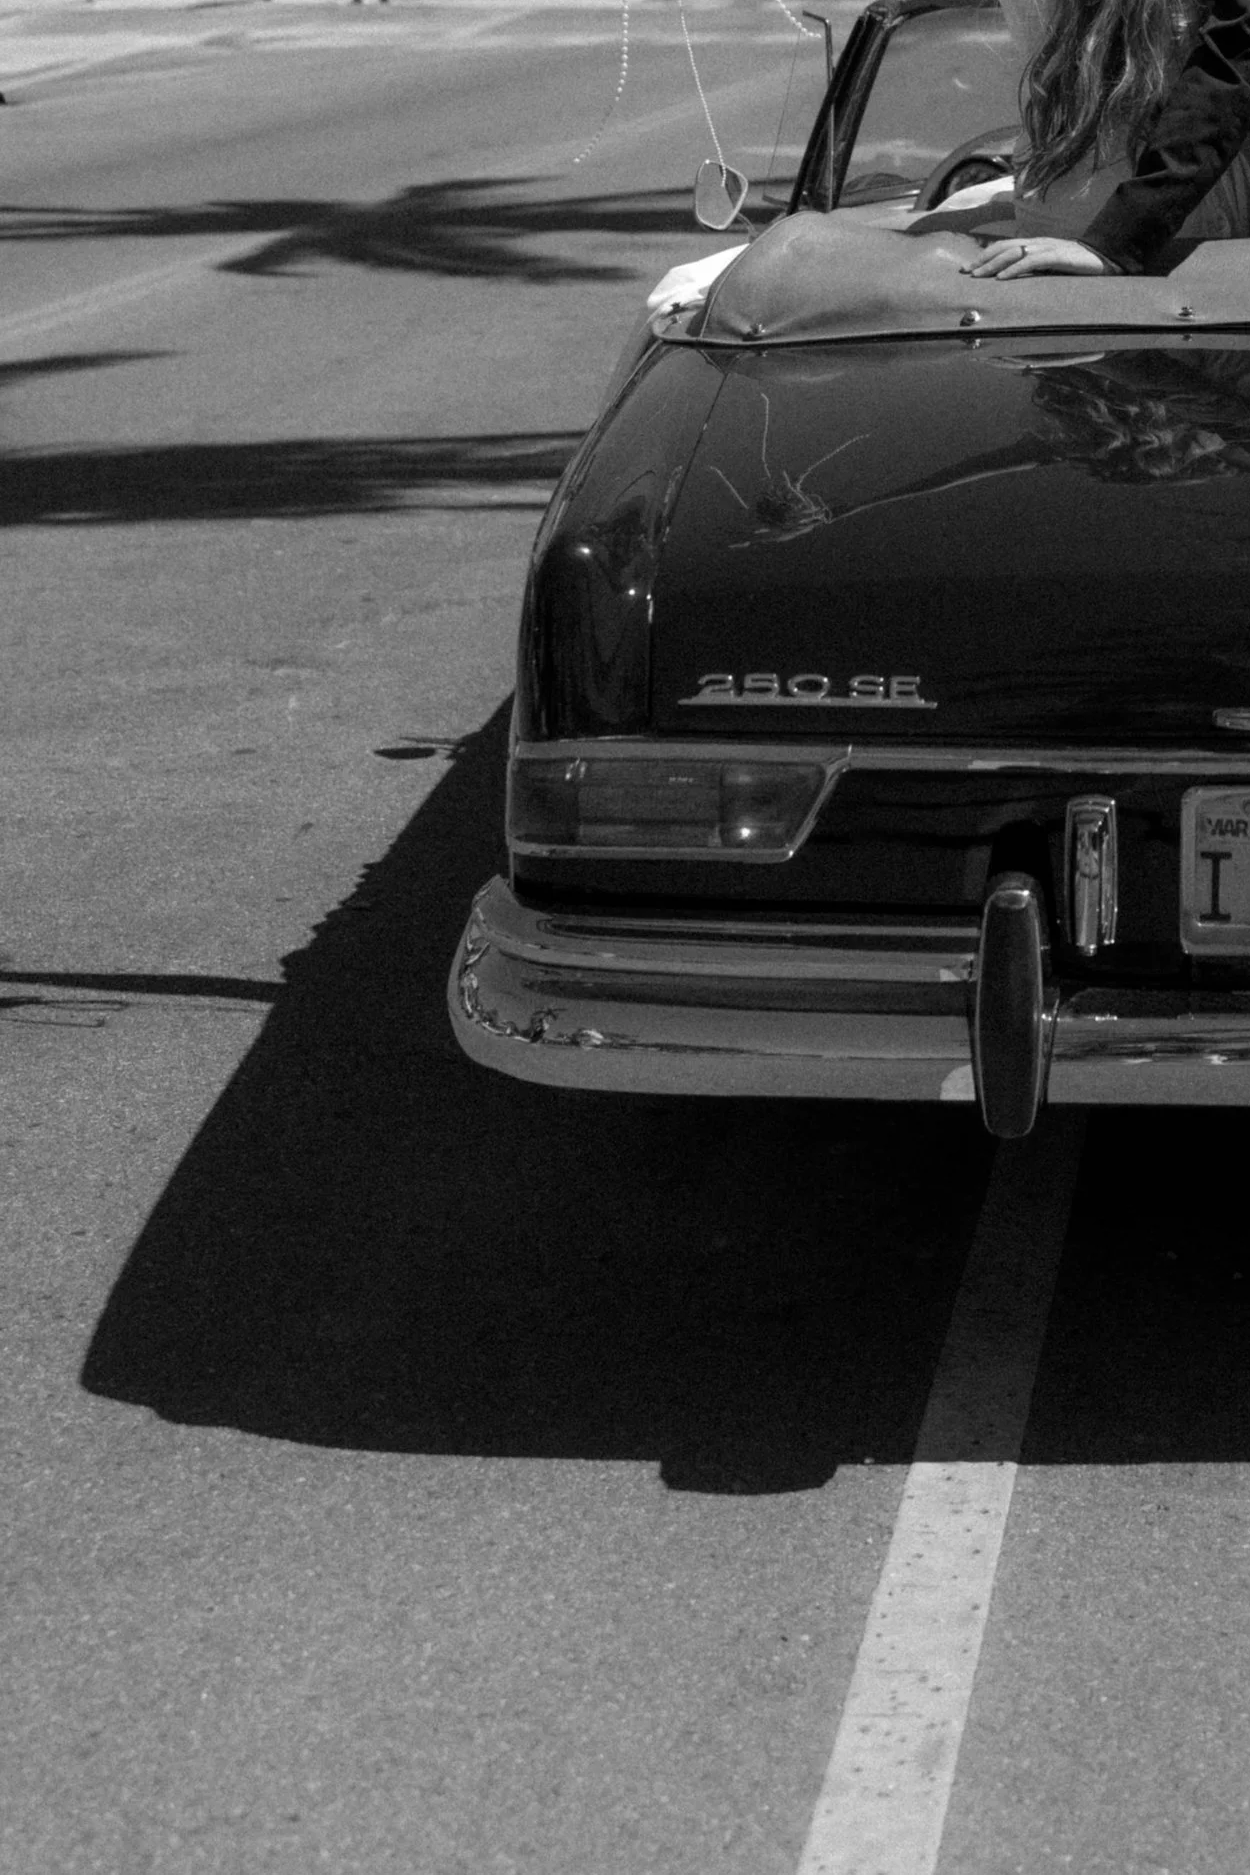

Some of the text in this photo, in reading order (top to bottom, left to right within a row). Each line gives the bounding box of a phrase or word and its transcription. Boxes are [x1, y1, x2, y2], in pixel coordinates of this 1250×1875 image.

[697, 673, 924, 702] 250 SE
[1205, 817, 1249, 837] MAR
[1199, 851, 1233, 923] I
